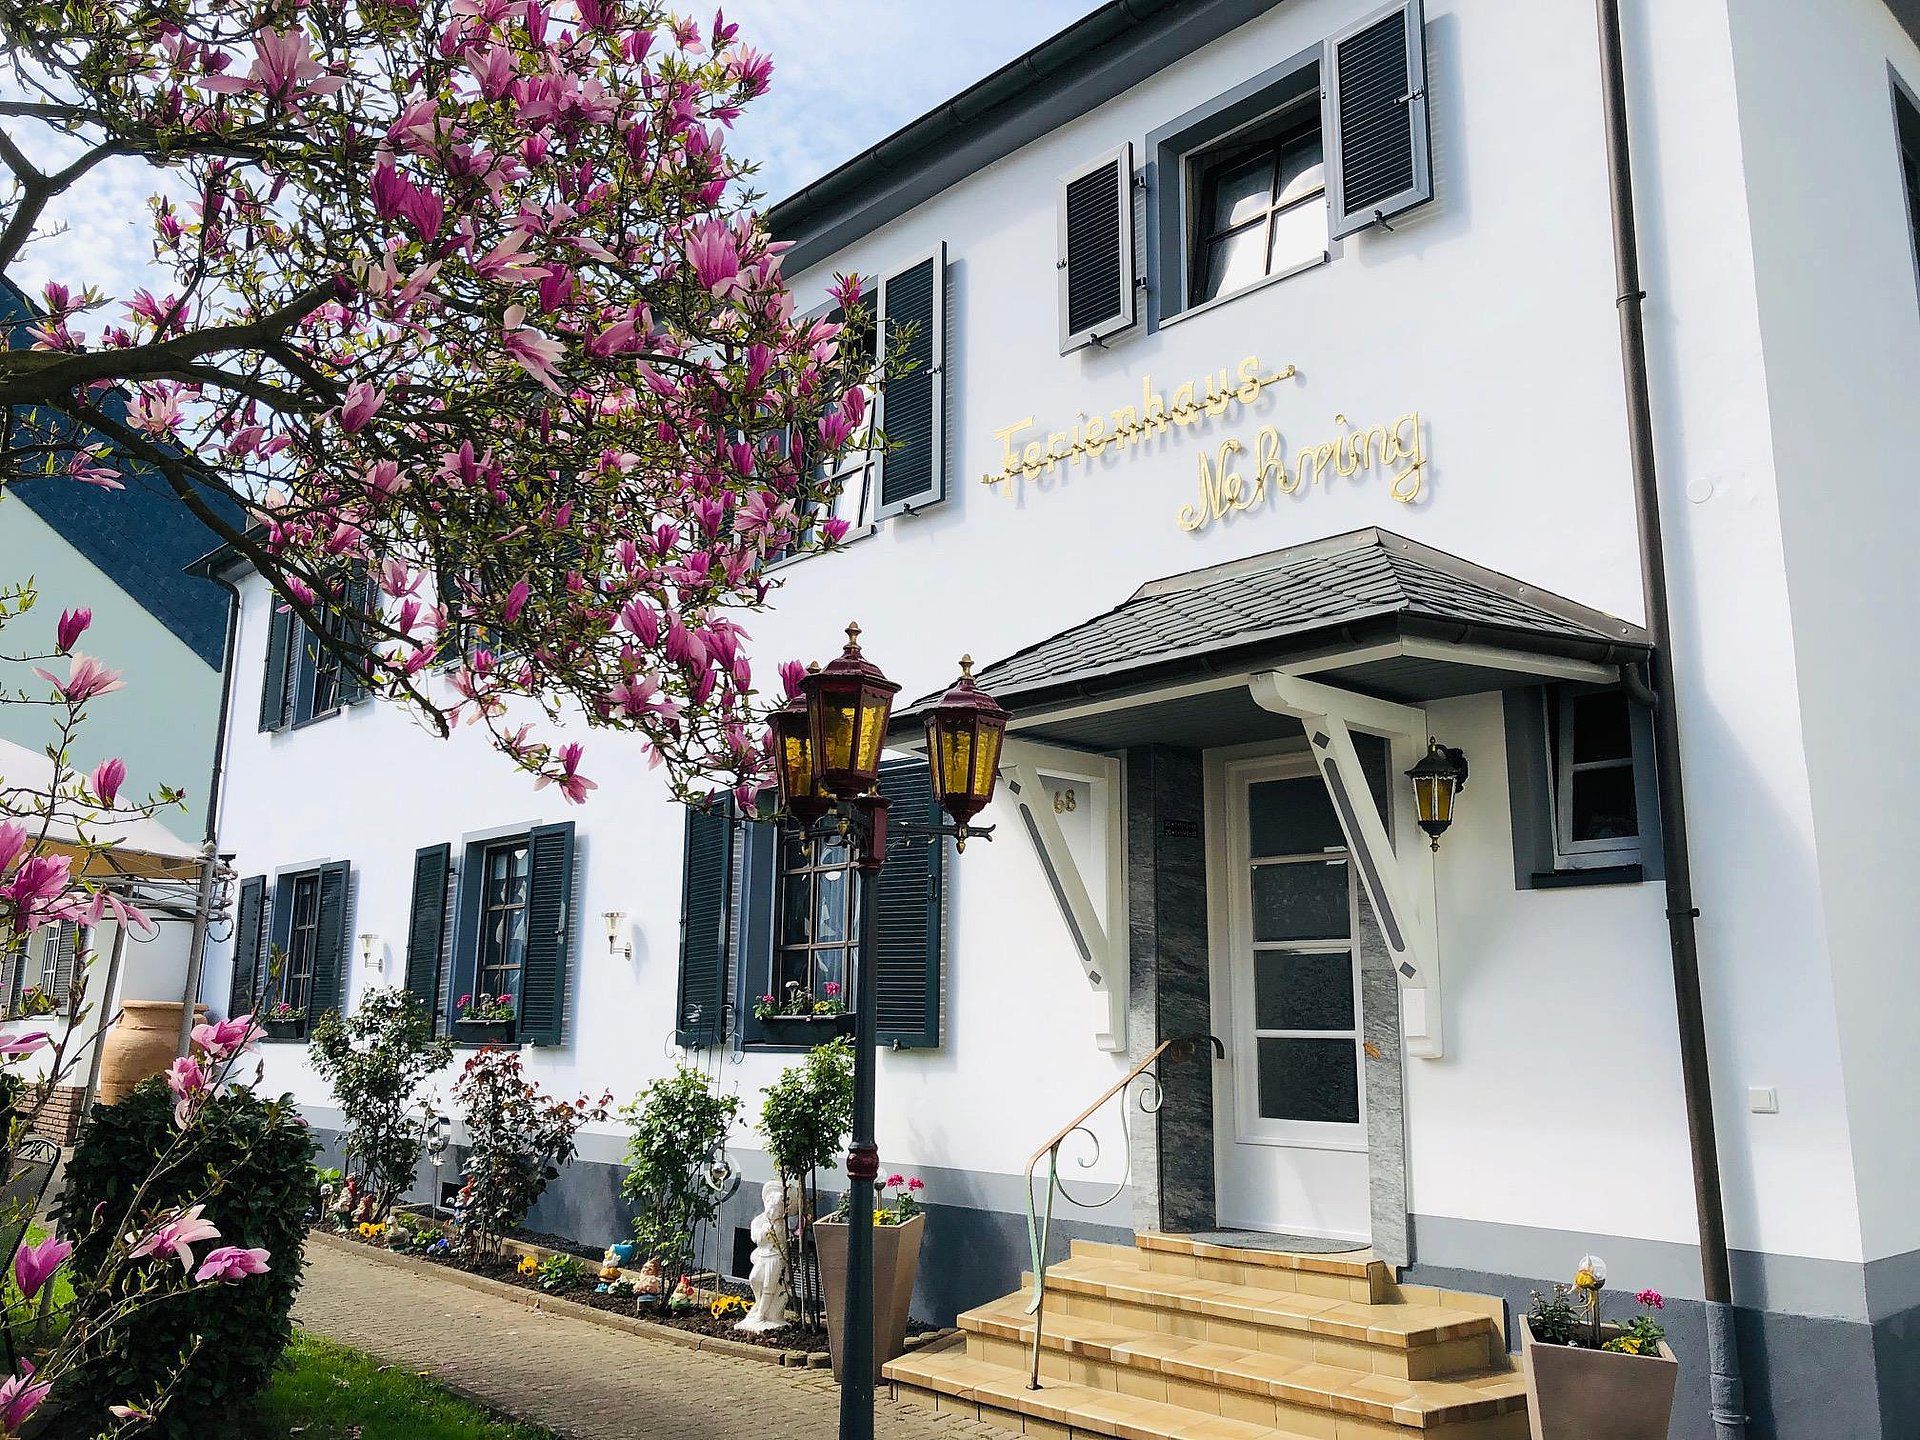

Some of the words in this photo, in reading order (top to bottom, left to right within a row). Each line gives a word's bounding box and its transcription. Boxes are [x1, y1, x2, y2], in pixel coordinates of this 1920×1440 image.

[991, 355, 1266, 498] Ferienhaus
[1175, 410, 1426, 532] Nehring
[1053, 787, 1077, 815] 68
